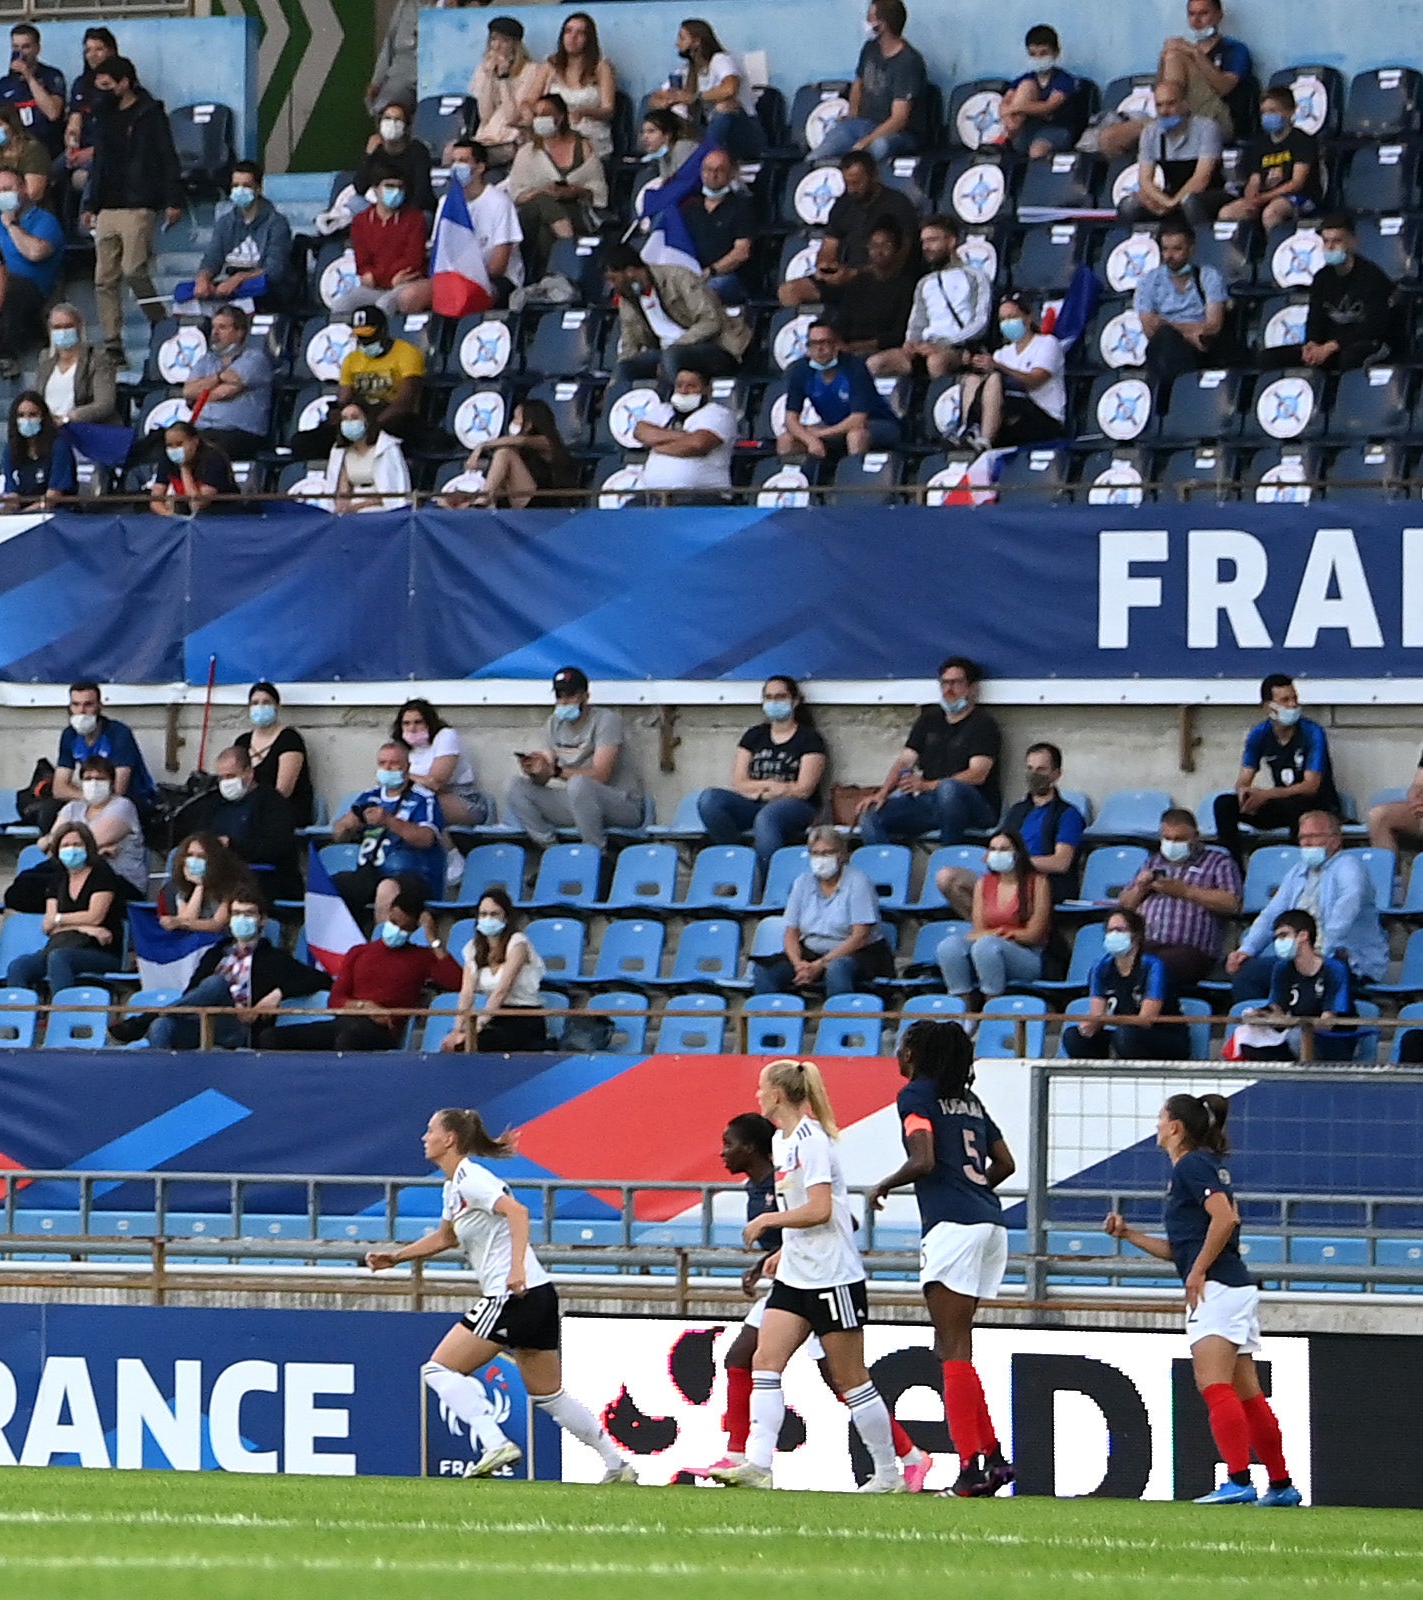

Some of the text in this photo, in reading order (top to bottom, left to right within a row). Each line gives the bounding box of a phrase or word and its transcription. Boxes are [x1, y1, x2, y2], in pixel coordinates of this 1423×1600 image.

[1099, 529, 1423, 649] FRA
[962, 1128, 988, 1186] 5
[465, 1297, 490, 1324] 9
[439, 1459, 515, 1477] FRE
